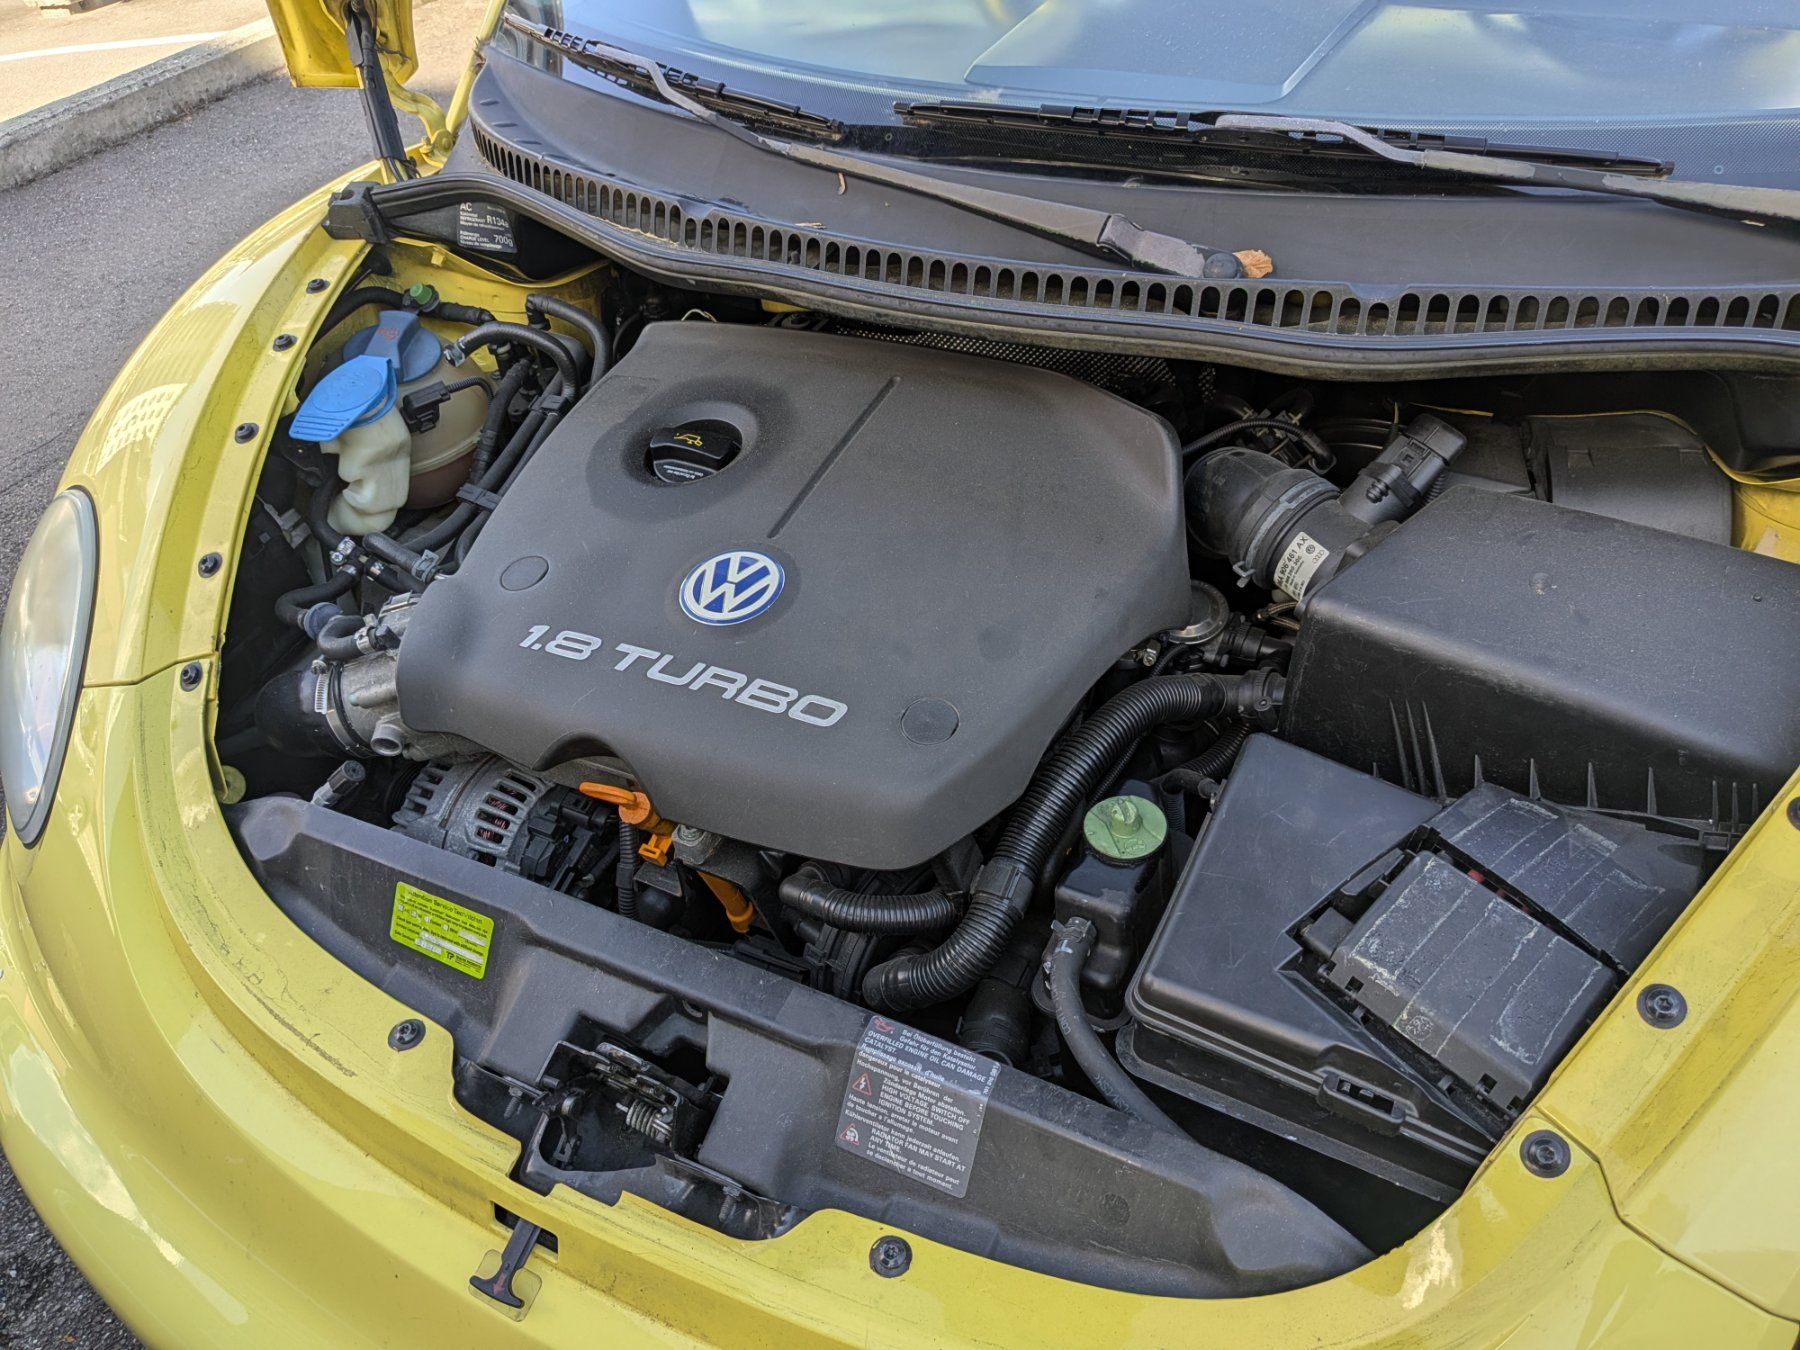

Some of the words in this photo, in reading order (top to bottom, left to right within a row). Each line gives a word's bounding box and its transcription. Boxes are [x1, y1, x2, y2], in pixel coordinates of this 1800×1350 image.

[460, 202, 472, 212] AC
[493, 234, 513, 247] 700g
[1287, 549, 1298, 563] 461
[1296, 535, 1309, 550] AX
[519, 625, 602, 661] 1.8
[614, 643, 848, 727] TURBO
[902, 1029, 913, 1037] Bei
[867, 1029, 904, 1049] OVERFILLED
[904, 1044, 928, 1059] ENGINE
[928, 1054, 940, 1064] OIL
[940, 1059, 955, 1070] CAN
[956, 1065, 986, 1082] DAMAGE
[898, 1035, 919, 1048] Gefahr
[929, 1047, 942, 1057] den
[888, 1062, 903, 1073] pour
[901, 1078, 912, 1086] vor
[942, 1094, 953, 1103] der
[917, 1091, 936, 1104] Motor
[877, 1097, 906, 1114] IGNITION
[879, 1090, 903, 1105] ENGINE
[904, 1100, 929, 1116] BEFORE
[929, 1111, 964, 1130] TOUCHING
[881, 1084, 898, 1096] HIGH
[930, 1104, 957, 1120] SWITCH
[957, 1115, 970, 1125] OFF
[848, 1092, 866, 1104] Haute
[918, 1123, 940, 1136] moteur
[940, 1132, 958, 1144] avant
[869, 1134, 883, 1145] ANY
[890, 1128, 906, 1139] kann
[870, 1127, 904, 1146] RADIATOR
[903, 1141, 918, 1152] FAN
[917, 1147, 934, 1159] MAY
[934, 1154, 955, 1168] START
[944, 1174, 960, 1185] peut
